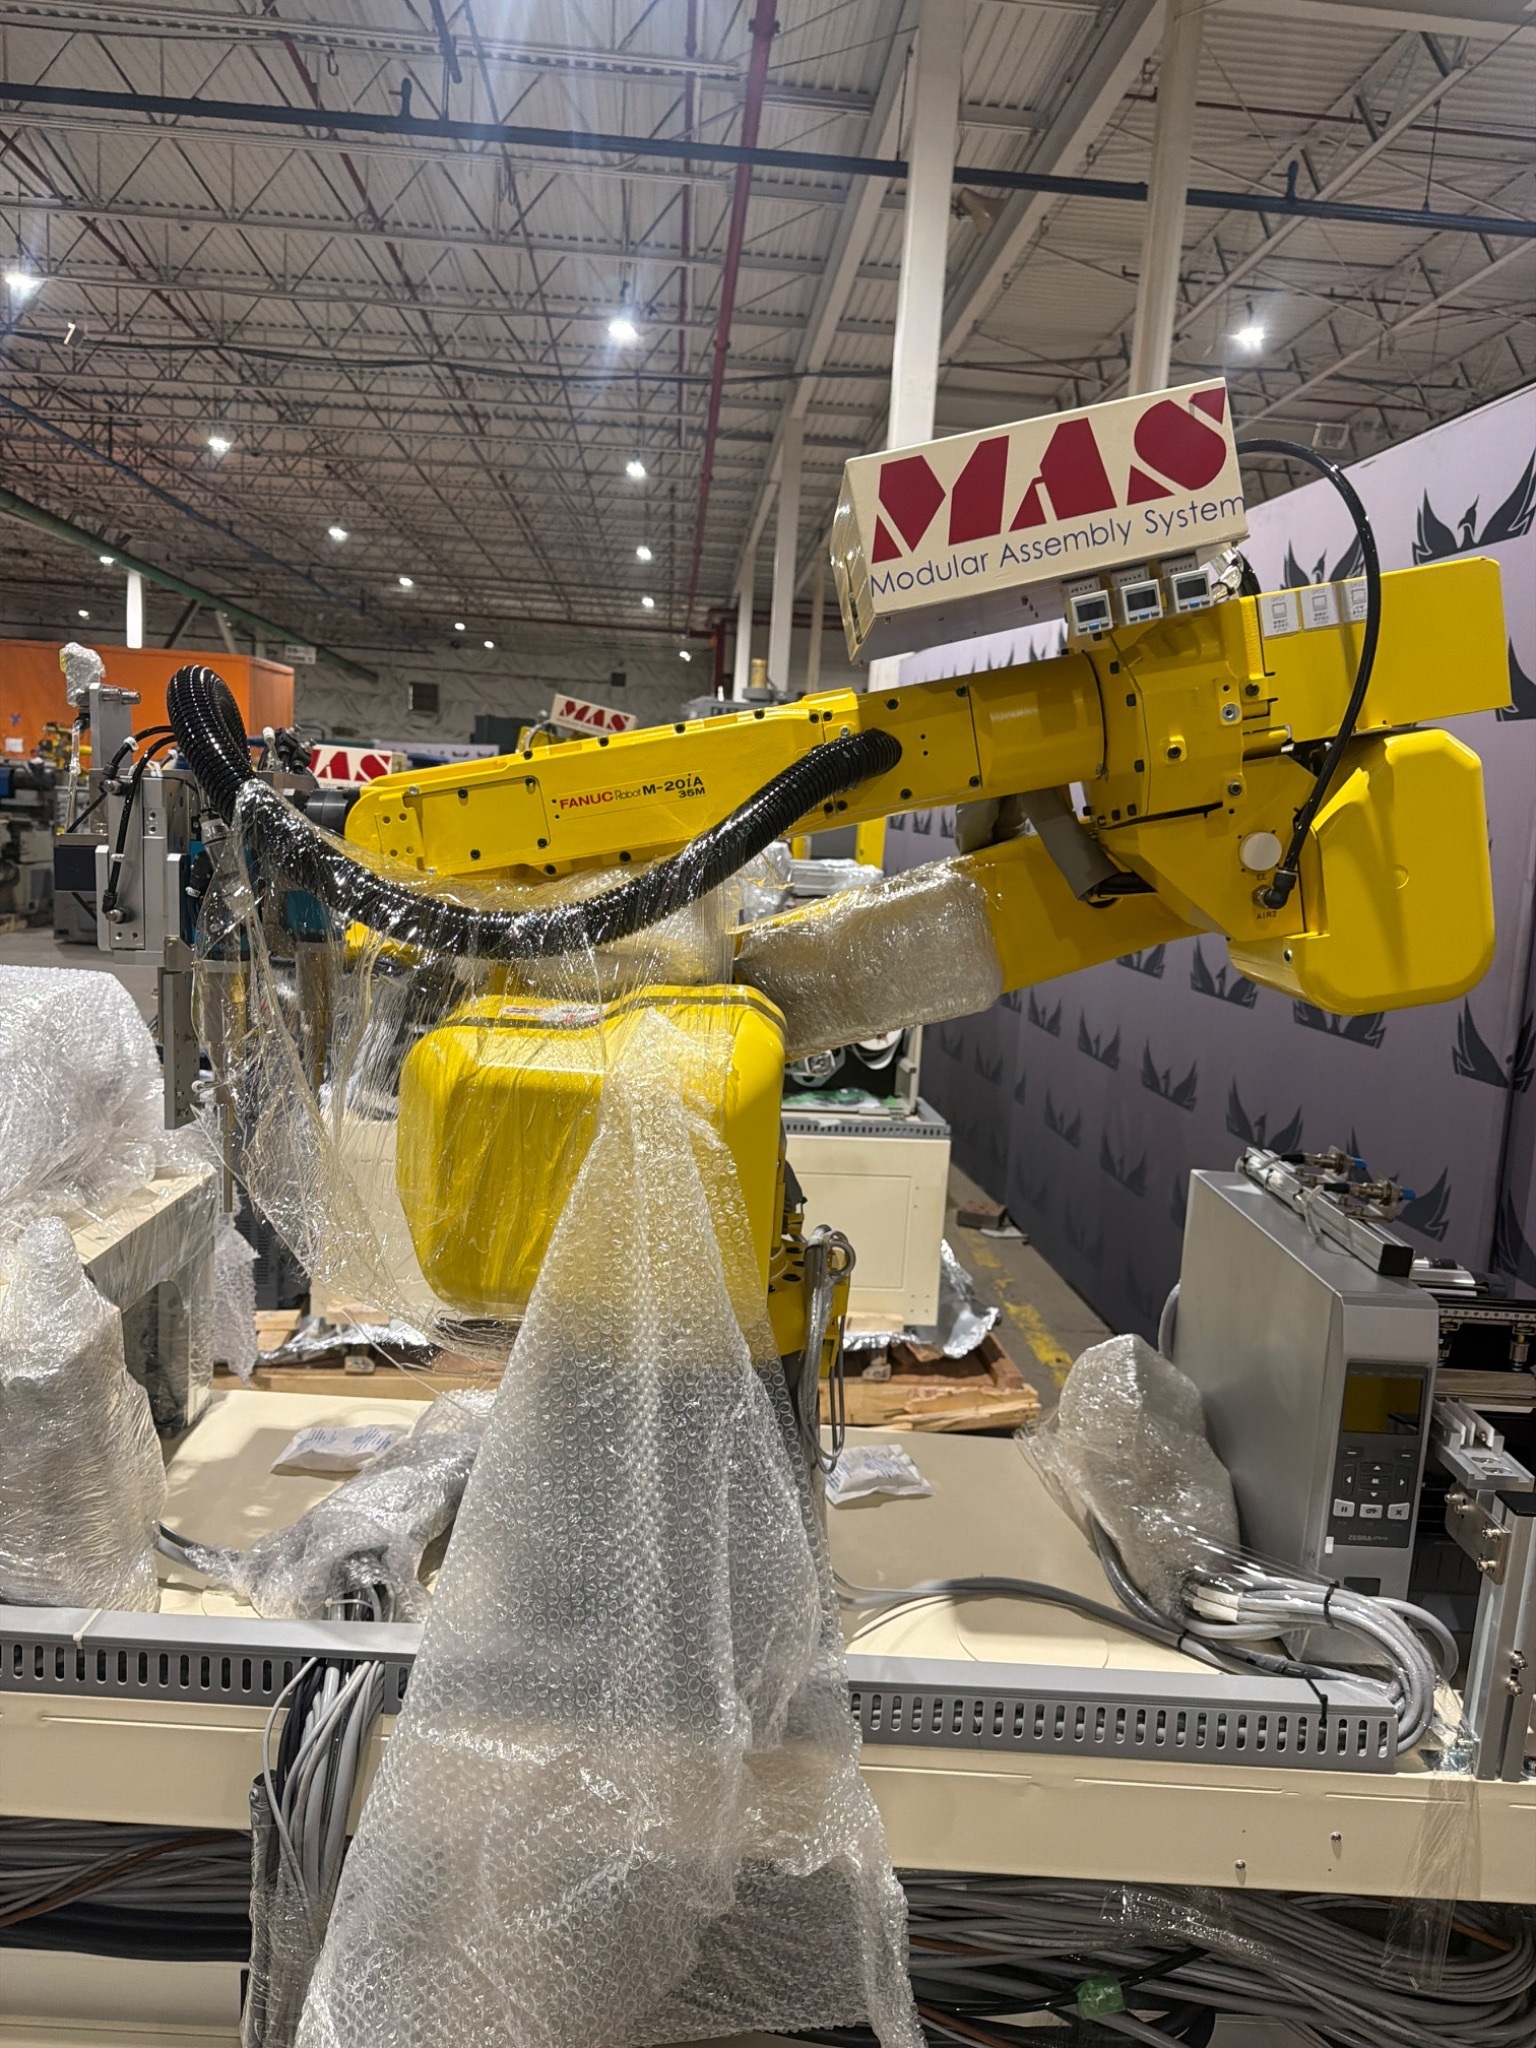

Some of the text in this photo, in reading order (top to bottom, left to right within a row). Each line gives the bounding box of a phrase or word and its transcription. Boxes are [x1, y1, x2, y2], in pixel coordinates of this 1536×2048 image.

[872, 387, 1227, 564] MAS
[870, 496, 1247, 597] Modular Assembly System
[559, 700, 630, 732] MAS
[559, 773, 704, 809] FANUC Robot M-20iA
[678, 787, 706, 798] 35M
[1256, 911, 1277, 920] AIR2
